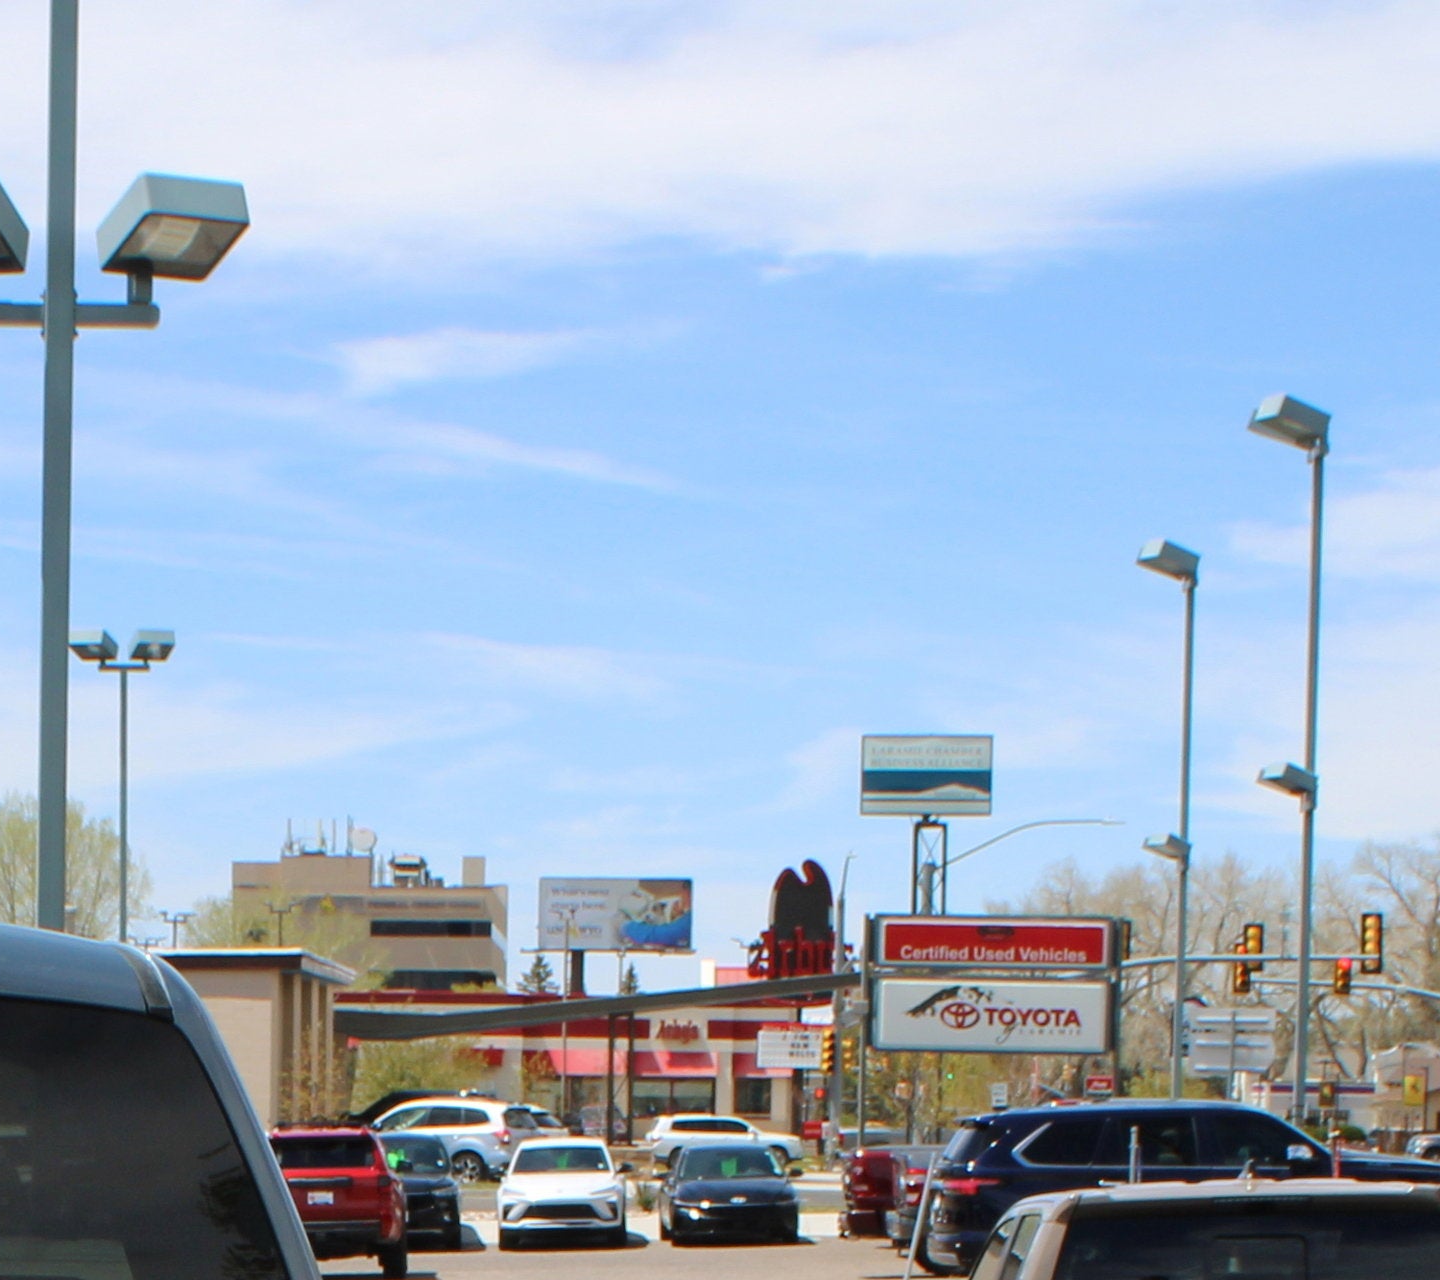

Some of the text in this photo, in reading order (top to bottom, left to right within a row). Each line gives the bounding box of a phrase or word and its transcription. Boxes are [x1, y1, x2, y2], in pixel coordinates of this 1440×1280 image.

[900, 945, 1087, 963] Certified Used Vehicles
[983, 1006, 1082, 1028] TOYOTA
